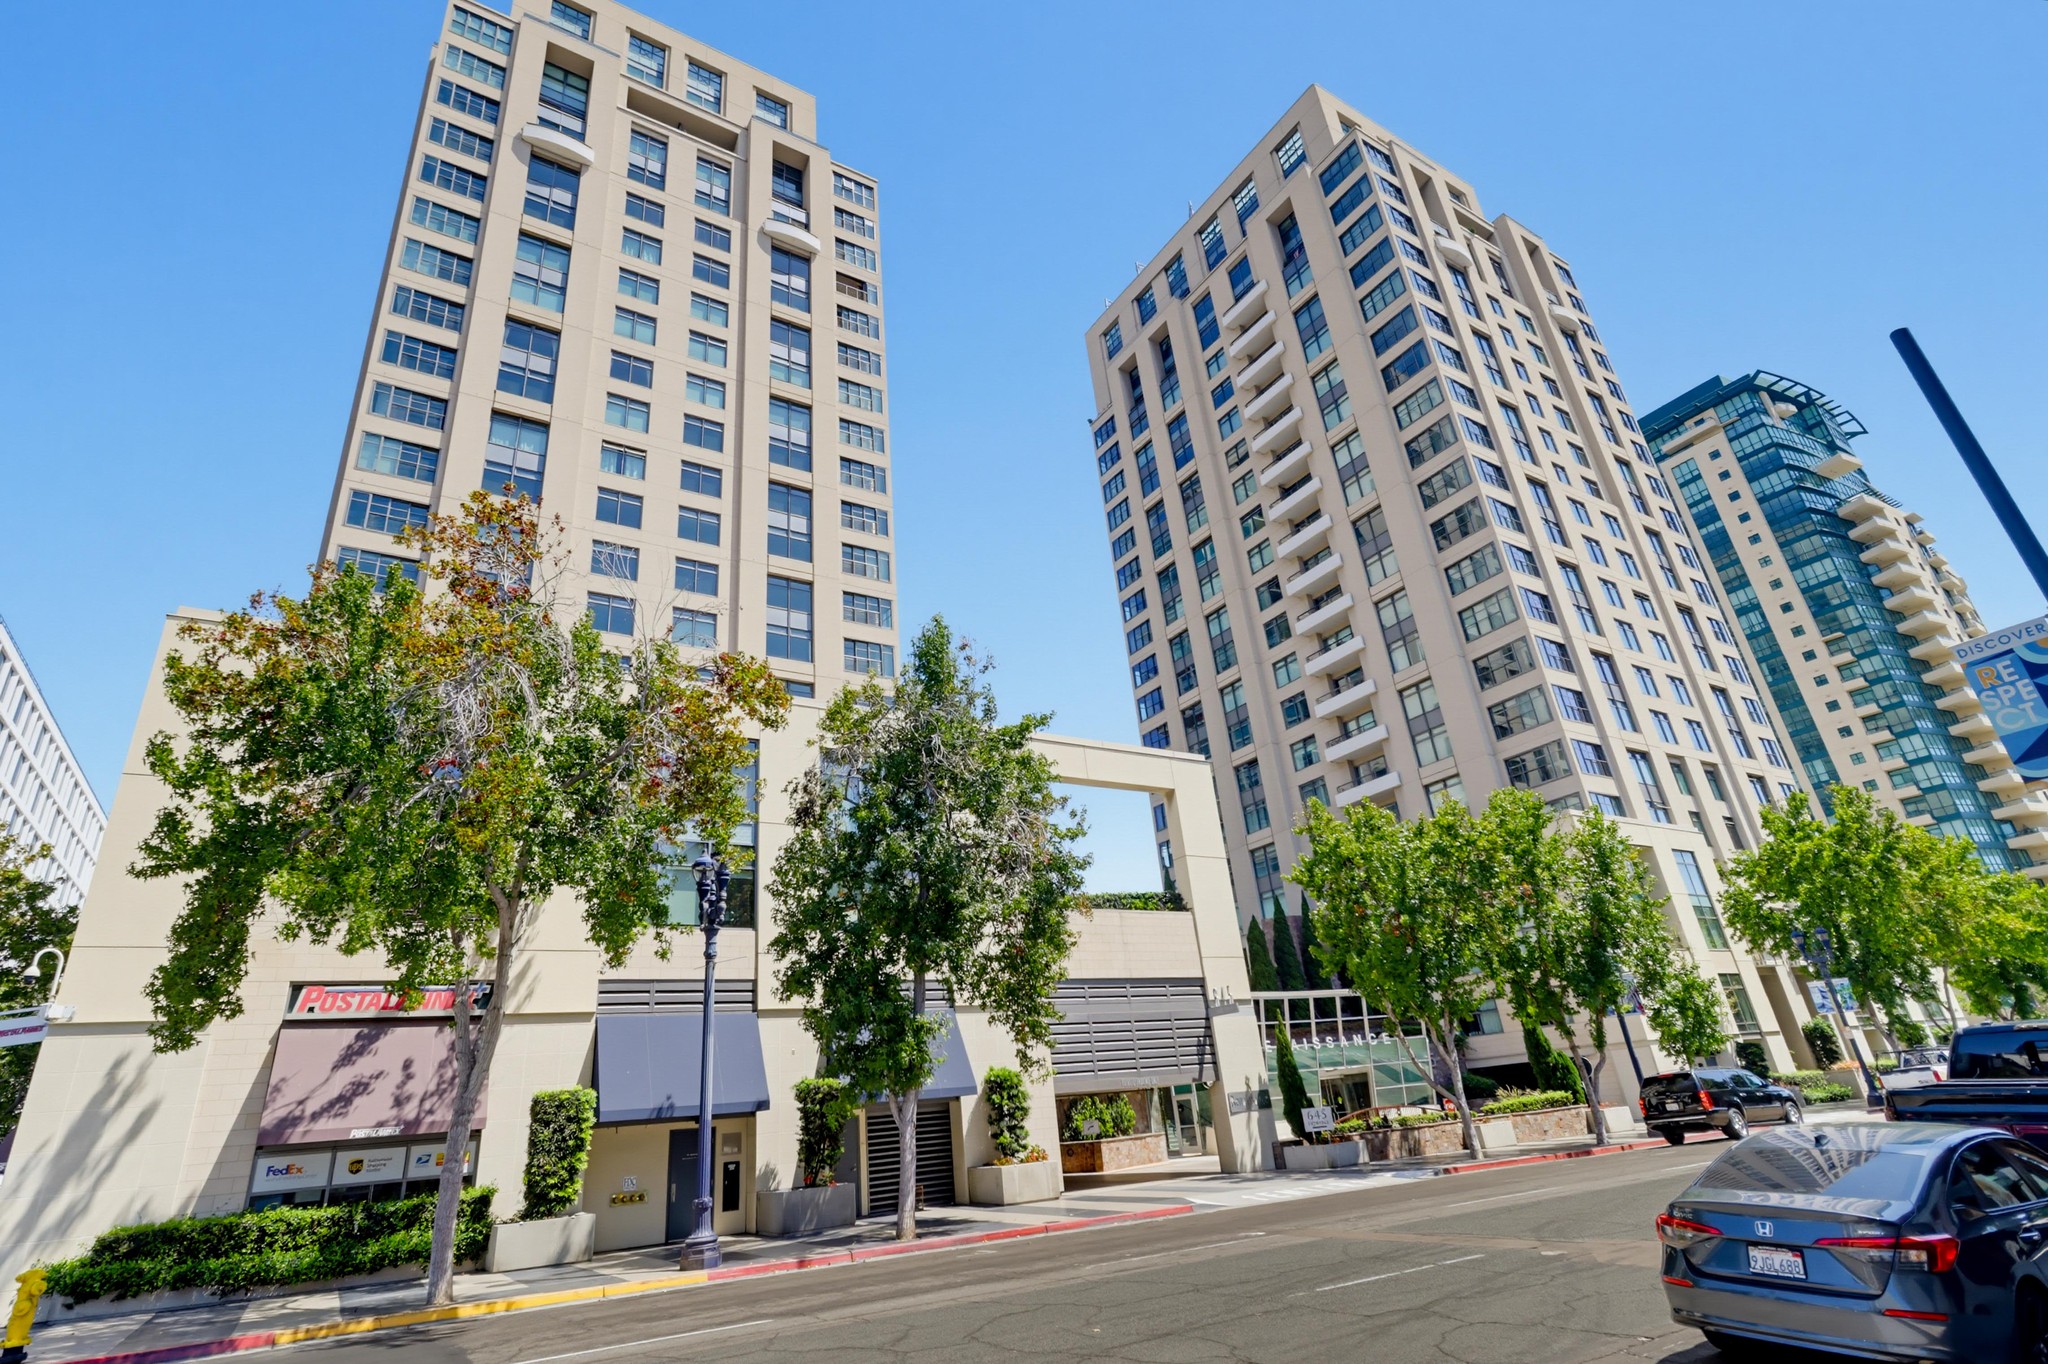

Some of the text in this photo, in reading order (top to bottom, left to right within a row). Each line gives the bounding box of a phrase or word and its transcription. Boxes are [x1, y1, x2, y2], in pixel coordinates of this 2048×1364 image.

[1957, 622, 2047, 660] DISCOVER
[1976, 659, 2018, 690] RE
[1980, 678, 2040, 711] SPE
[1995, 701, 2038, 730] CT
[1264, 1032, 1391, 1053] EAISSANCE
[266, 1163, 304, 1178] FedEx
[1751, 1255, 1801, 1274] 9JGL688
